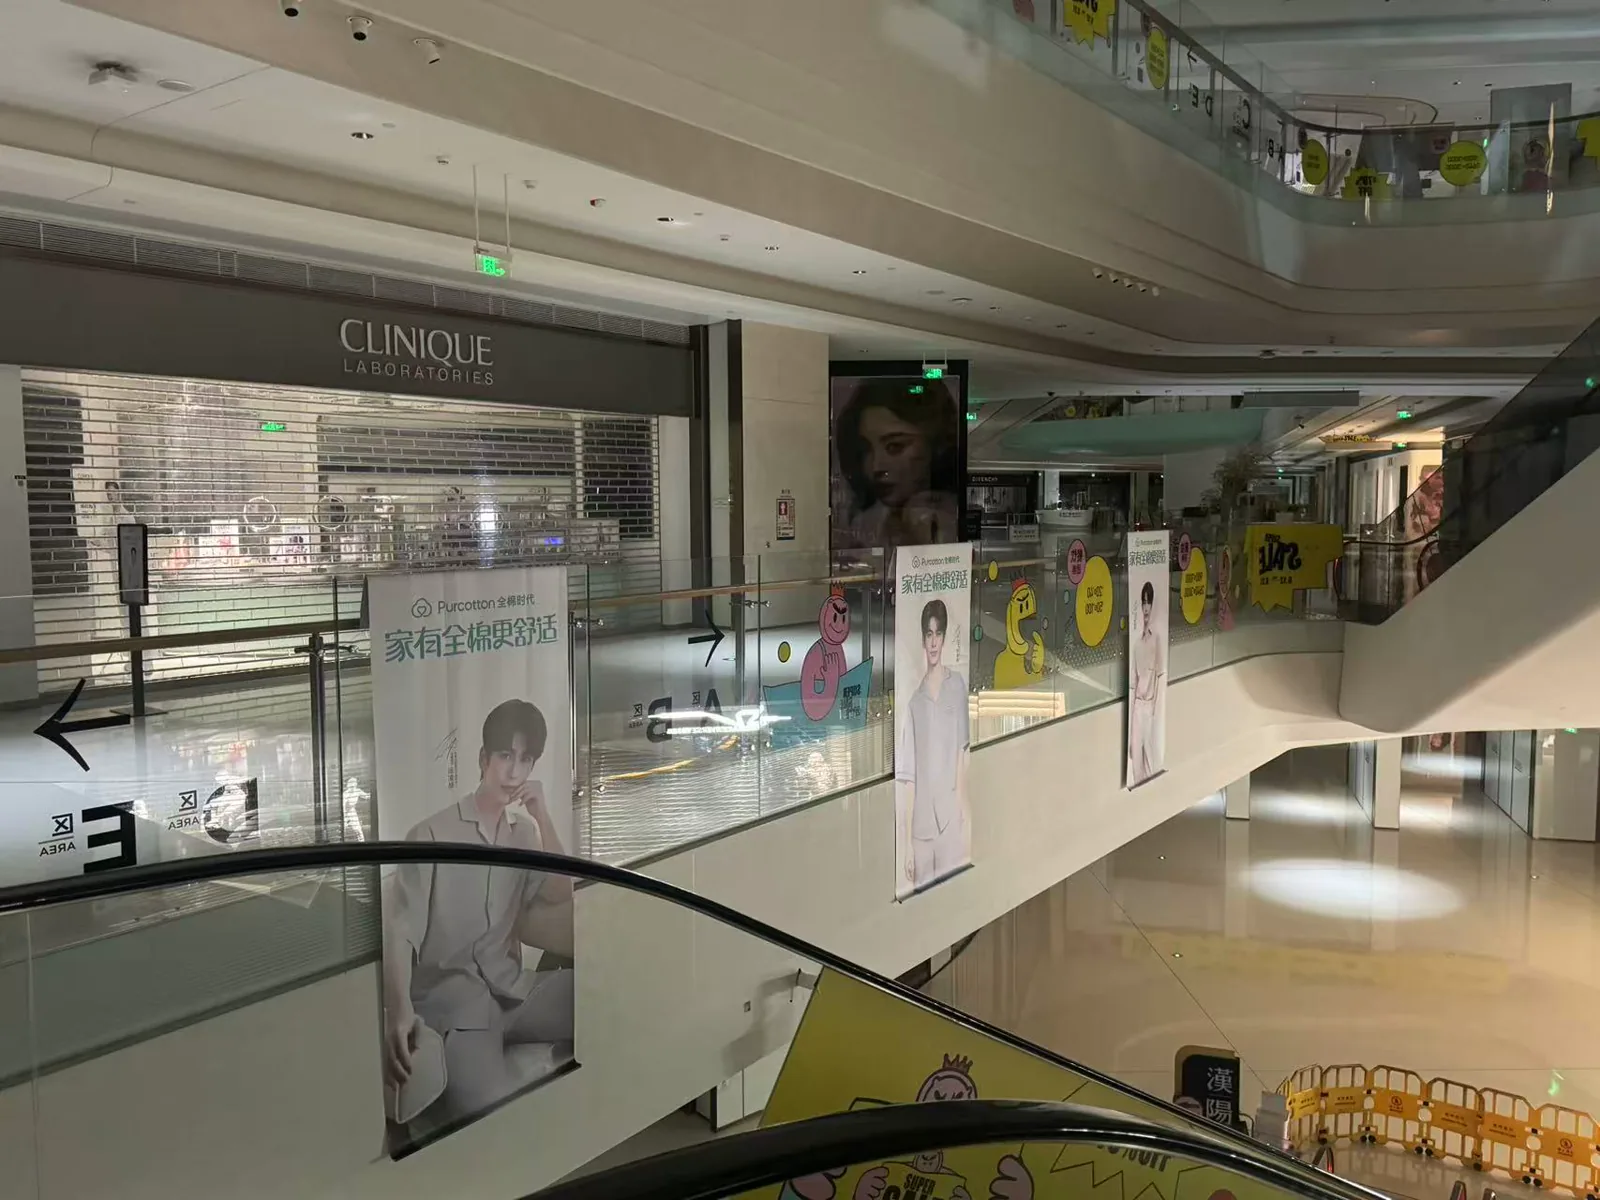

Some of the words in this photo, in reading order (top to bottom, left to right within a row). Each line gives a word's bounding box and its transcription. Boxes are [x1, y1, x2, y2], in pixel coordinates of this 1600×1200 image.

[339, 317, 494, 368] CLINIQUE
[343, 359, 495, 386] LABORATORIES
[901, 569, 968, 595] 家有全棉更舒适
[437, 597, 496, 615] Purcotton
[496, 592, 536, 609] 全棉时代
[384, 612, 559, 664] 家有全棉更舒适
[1206, 1067, 1234, 1126] 漢陽
[903, 1173, 936, 1196] SUPER
